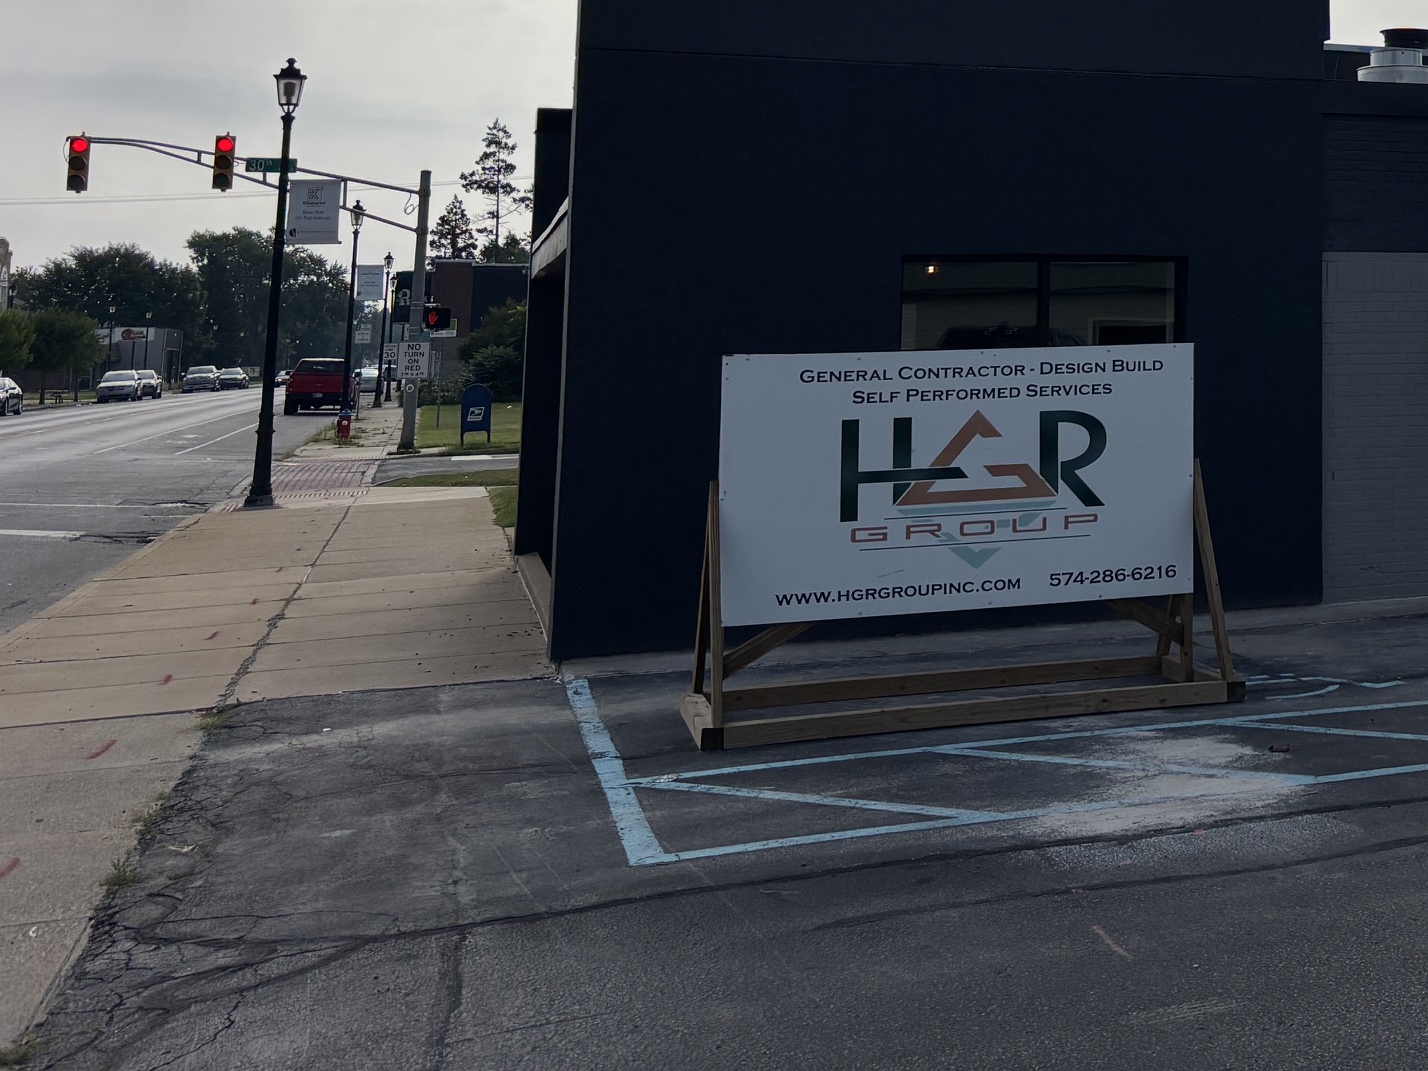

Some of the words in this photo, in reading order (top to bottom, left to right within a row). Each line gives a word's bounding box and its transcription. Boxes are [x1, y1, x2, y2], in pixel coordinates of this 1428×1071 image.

[384, 351, 396, 359] 30
[799, 367, 893, 383] GENERAL
[897, 364, 1027, 381] CONTRACTOR
[1039, 361, 1107, 376] DESIGN
[1111, 358, 1164, 373] BUILD
[852, 389, 901, 405] SELF
[905, 386, 1021, 403] PERFORMED
[1026, 383, 1113, 398] SERVICES
[840, 409, 1108, 522] HGR
[850, 512, 1099, 544] GROUP
[775, 577, 1022, 607] WWW.HGRGROUPINC.COM
[1048, 563, 1178, 588] 574-286-6216
